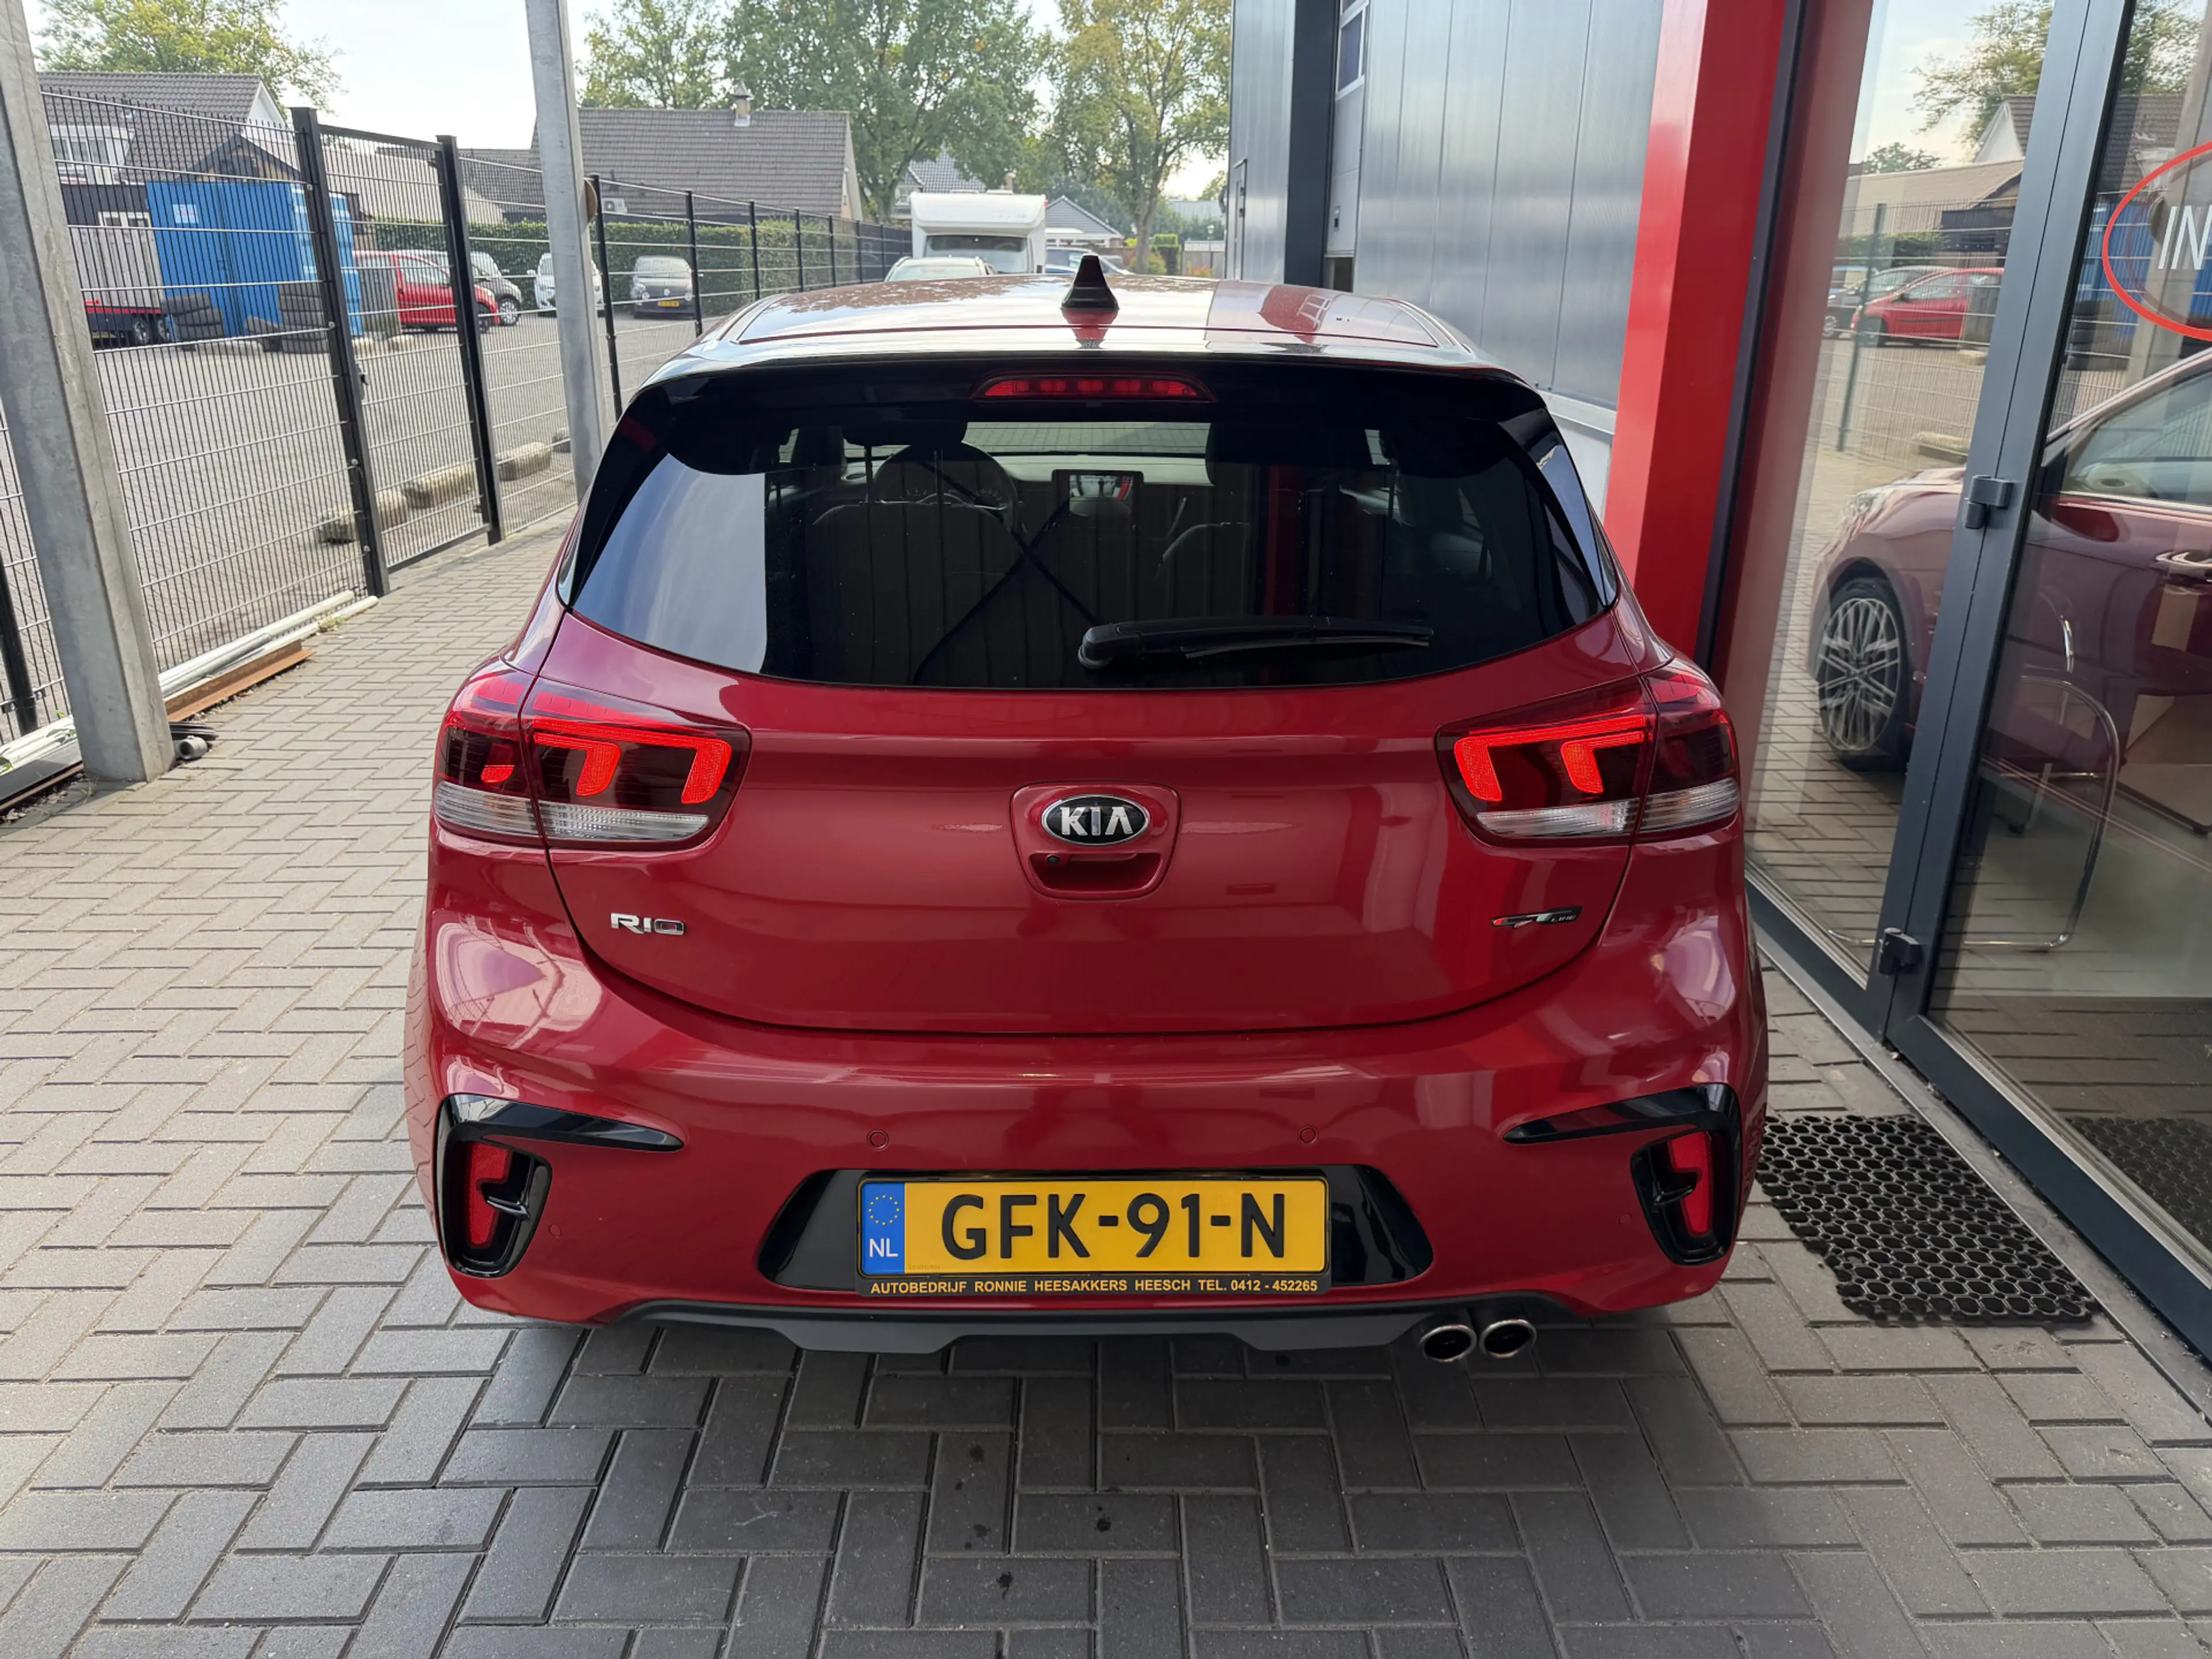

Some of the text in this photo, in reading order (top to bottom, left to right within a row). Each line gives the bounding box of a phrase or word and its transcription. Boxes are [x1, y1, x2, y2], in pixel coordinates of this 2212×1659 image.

[1060, 806, 1133, 835] KIA
[611, 912, 684, 935] RIO
[942, 1193, 1285, 1260] GFK-91-N
[869, 1238, 899, 1257] NL
[870, 1281, 967, 1294] AUTOBEDRIJF
[974, 1281, 1027, 1293] RONNIE
[1035, 1280, 1127, 1292] HEESAKKERS
[1135, 1279, 1190, 1291] HEESCH
[1198, 1279, 1226, 1291] TEL.
[1230, 1279, 1261, 1291] 0412
[1272, 1279, 1318, 1291] 452265
